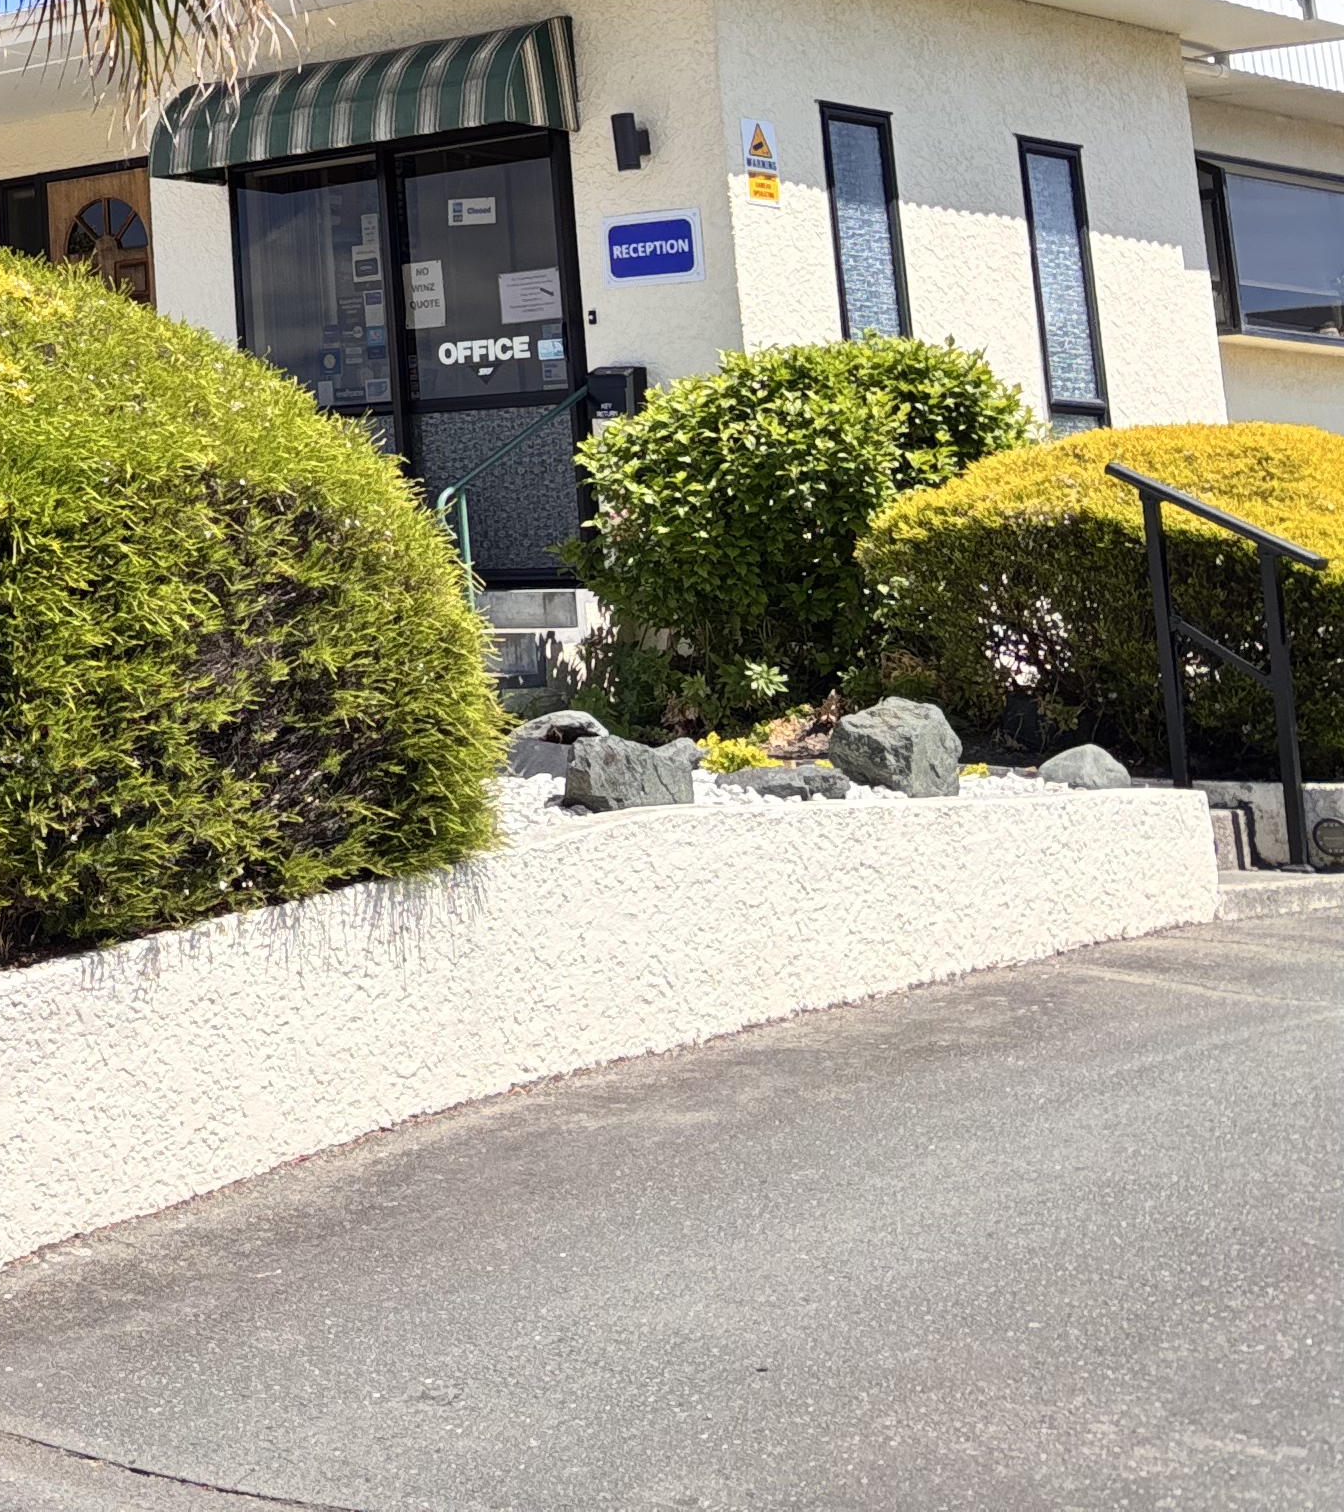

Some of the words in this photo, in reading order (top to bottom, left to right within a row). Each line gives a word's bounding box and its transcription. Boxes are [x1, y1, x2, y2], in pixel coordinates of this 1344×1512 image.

[746, 157, 777, 170] WARNING
[613, 238, 690, 259] RECEPTION
[415, 267, 430, 277] NO
[409, 298, 441, 311] QUOTE
[438, 335, 531, 365] OFFICE
